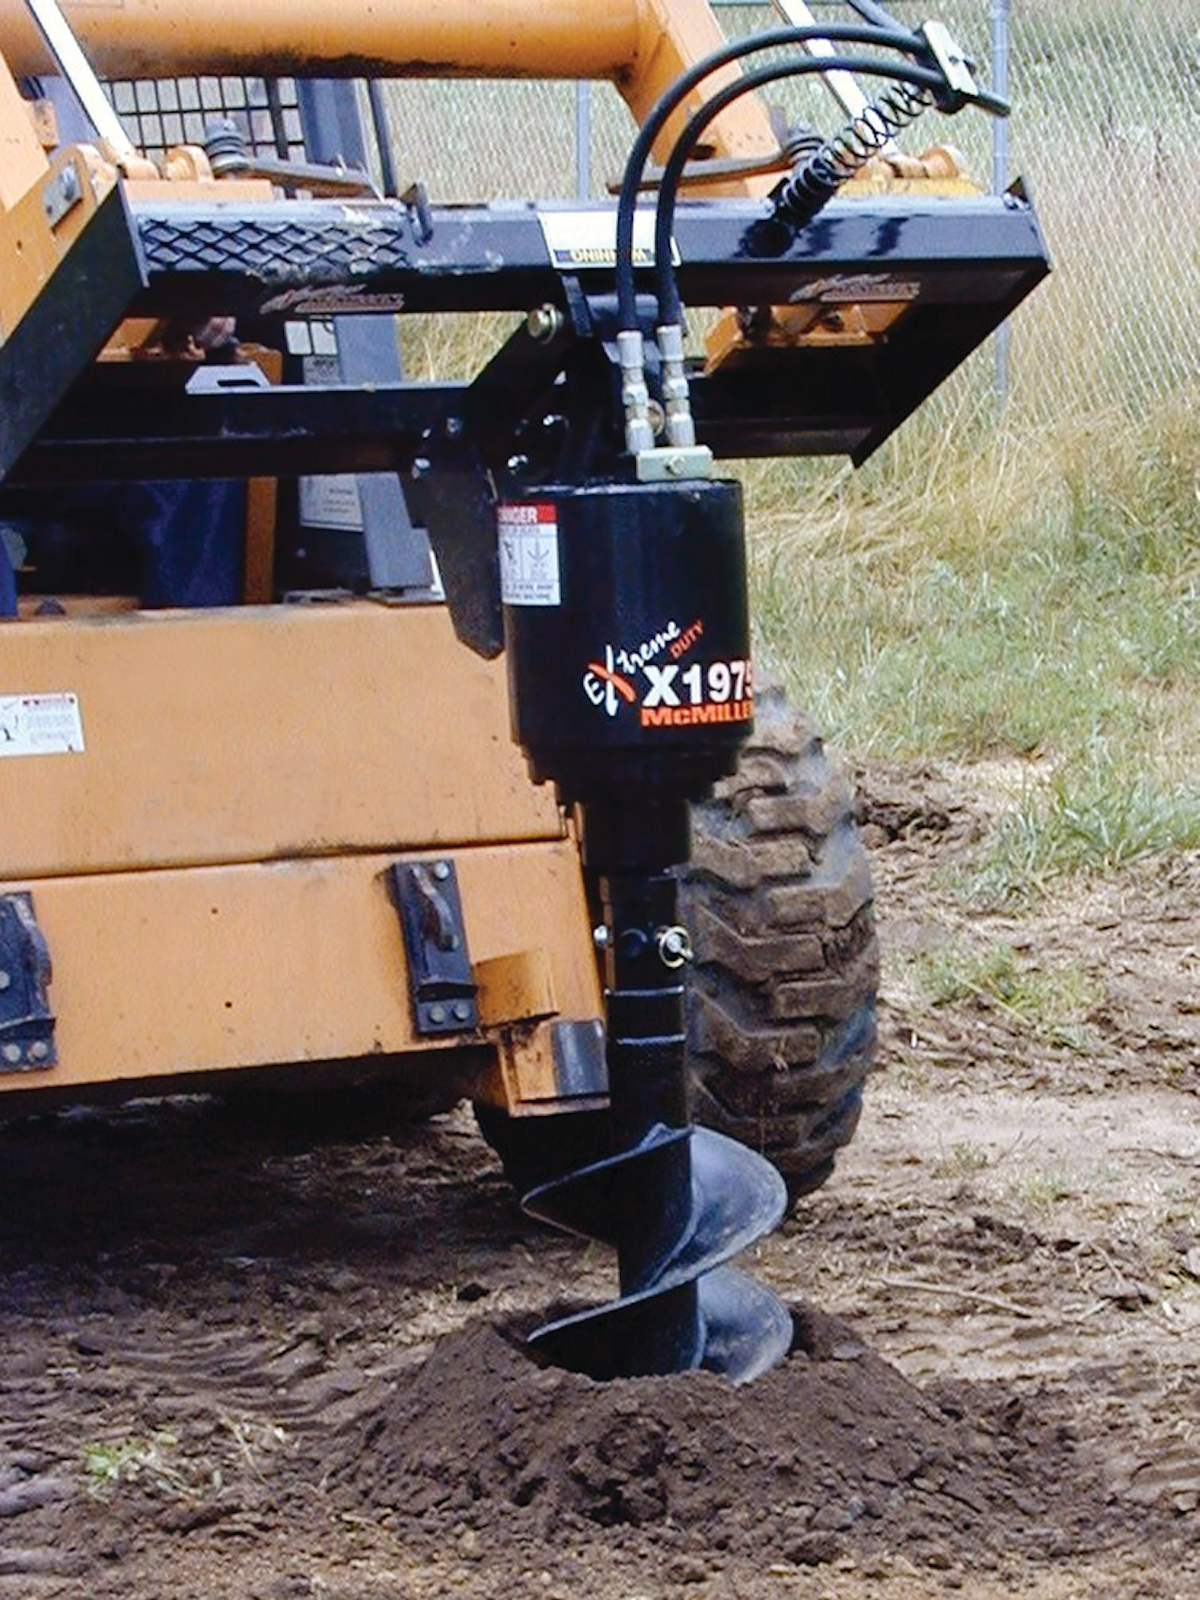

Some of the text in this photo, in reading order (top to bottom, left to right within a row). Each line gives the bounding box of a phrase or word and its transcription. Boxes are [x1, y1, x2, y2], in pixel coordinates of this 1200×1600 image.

[571, 249, 650, 263] WNING
[498, 506, 538, 523] NGER
[670, 619, 704, 659] DUTY
